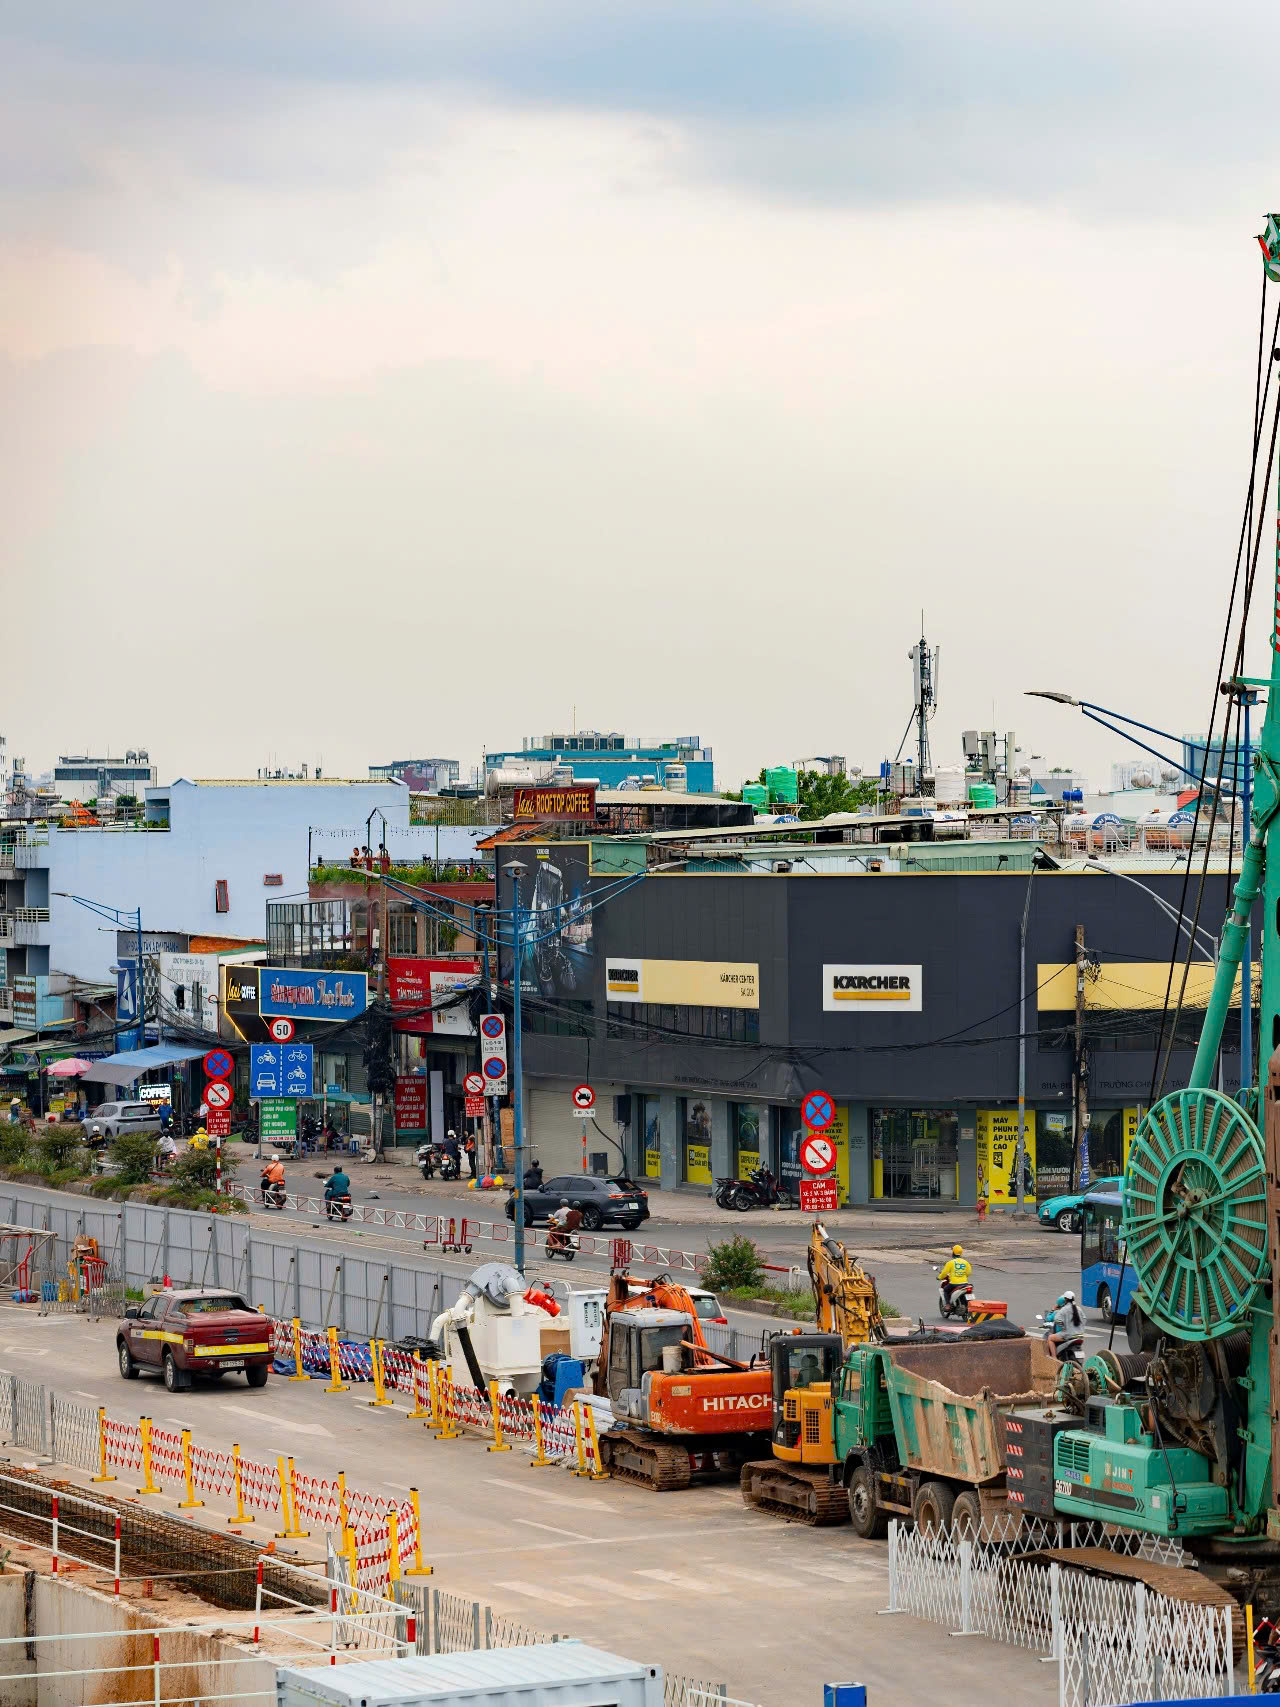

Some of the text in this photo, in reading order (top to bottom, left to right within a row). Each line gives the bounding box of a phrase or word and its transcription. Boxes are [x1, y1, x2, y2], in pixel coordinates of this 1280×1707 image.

[536, 792, 565, 813] ROOFTOP
[566, 792, 590, 813] COFFEE
[833, 975, 911, 990] KÄRCHER
[276, 1024, 289, 1036] 50
[140, 1087, 171, 1099] COFFEE
[992, 1124, 1030, 1133] PHUN RA
[992, 1133, 1003, 1141] ÁP
[954, 1261, 967, 1270] be
[703, 1394, 773, 1411] HITACH
